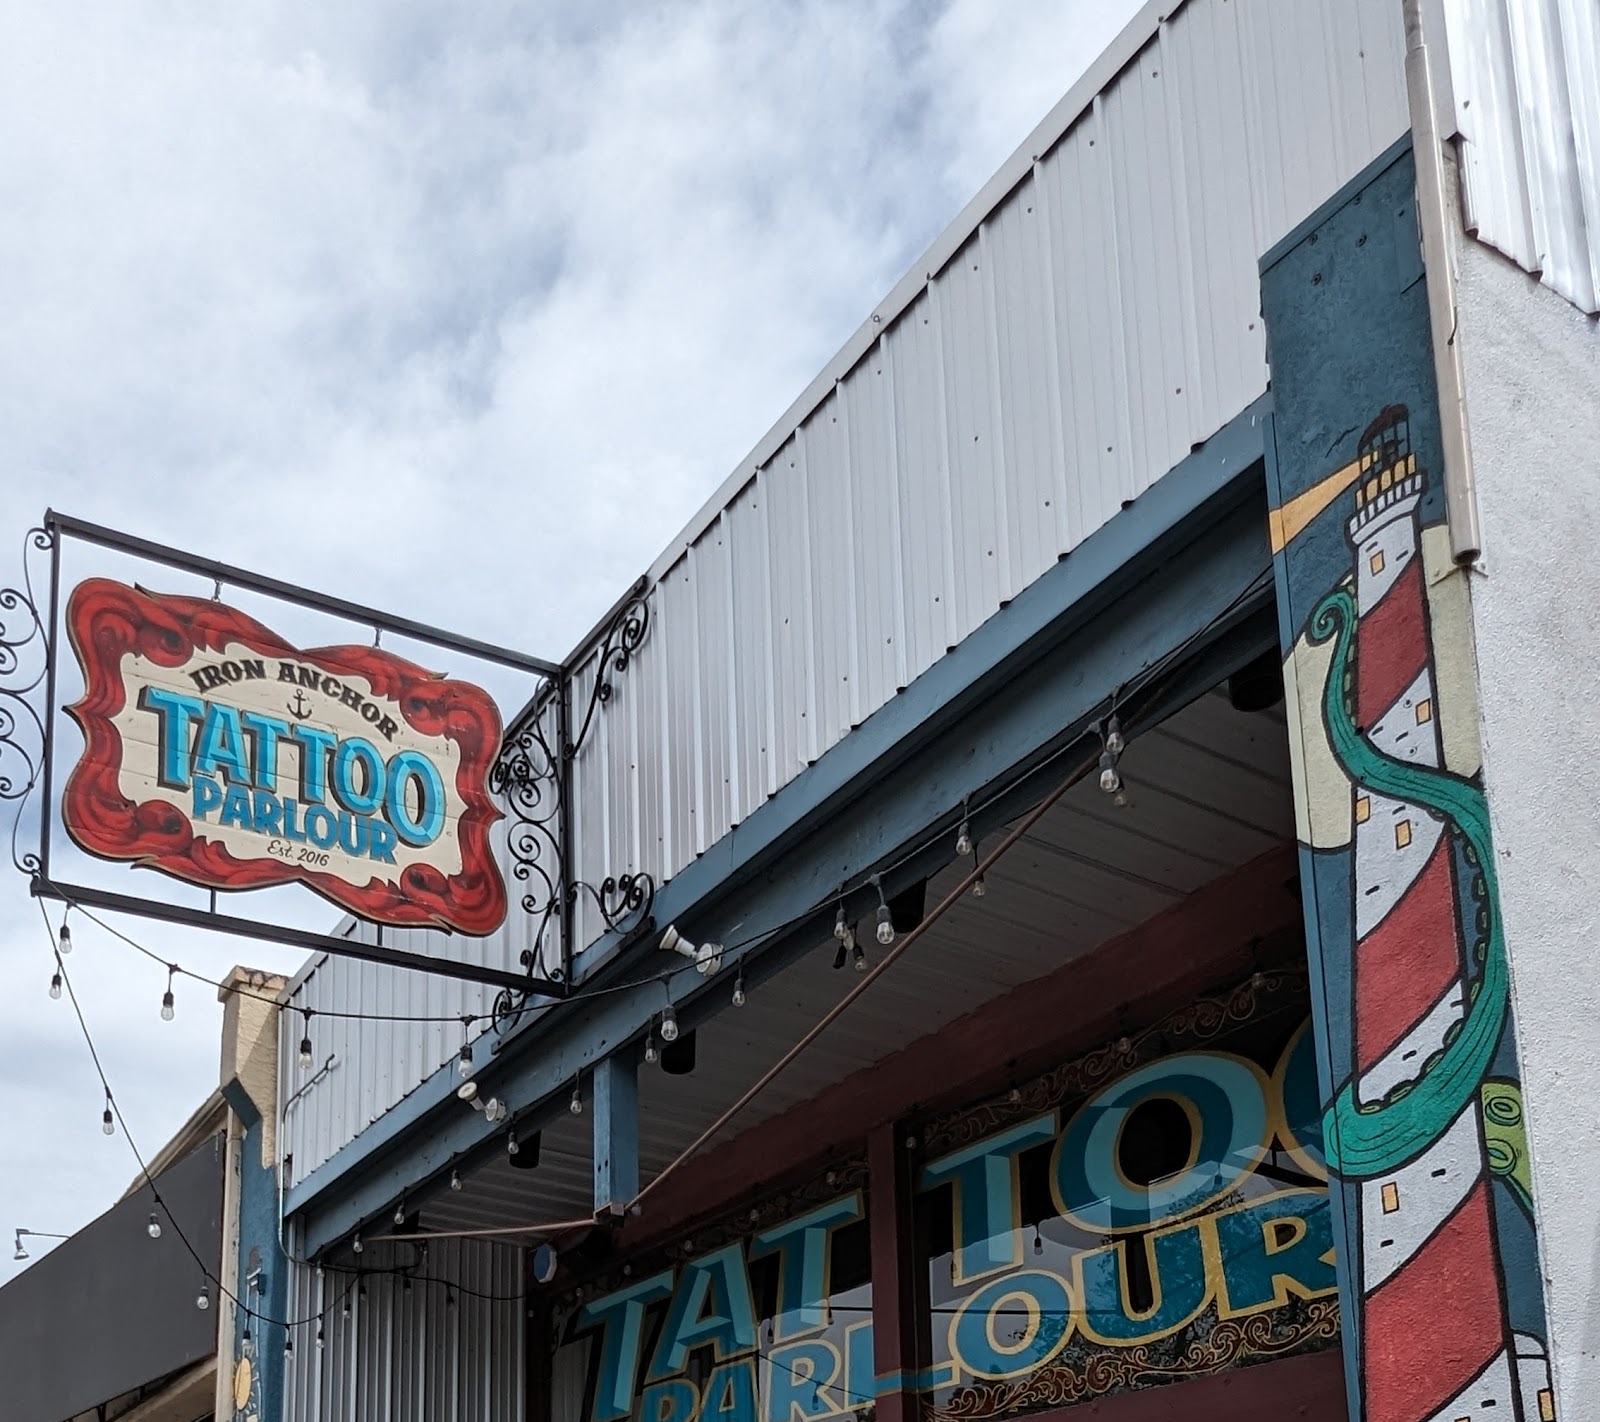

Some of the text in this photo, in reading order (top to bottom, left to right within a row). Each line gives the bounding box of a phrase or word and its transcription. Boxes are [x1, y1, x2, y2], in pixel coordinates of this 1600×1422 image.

[189, 659, 399, 743] IRON ANCHOR
[138, 684, 446, 847] TATTOO
[192, 775, 399, 865] PARLOUR
[266, 840, 330, 867] Est. 2016
